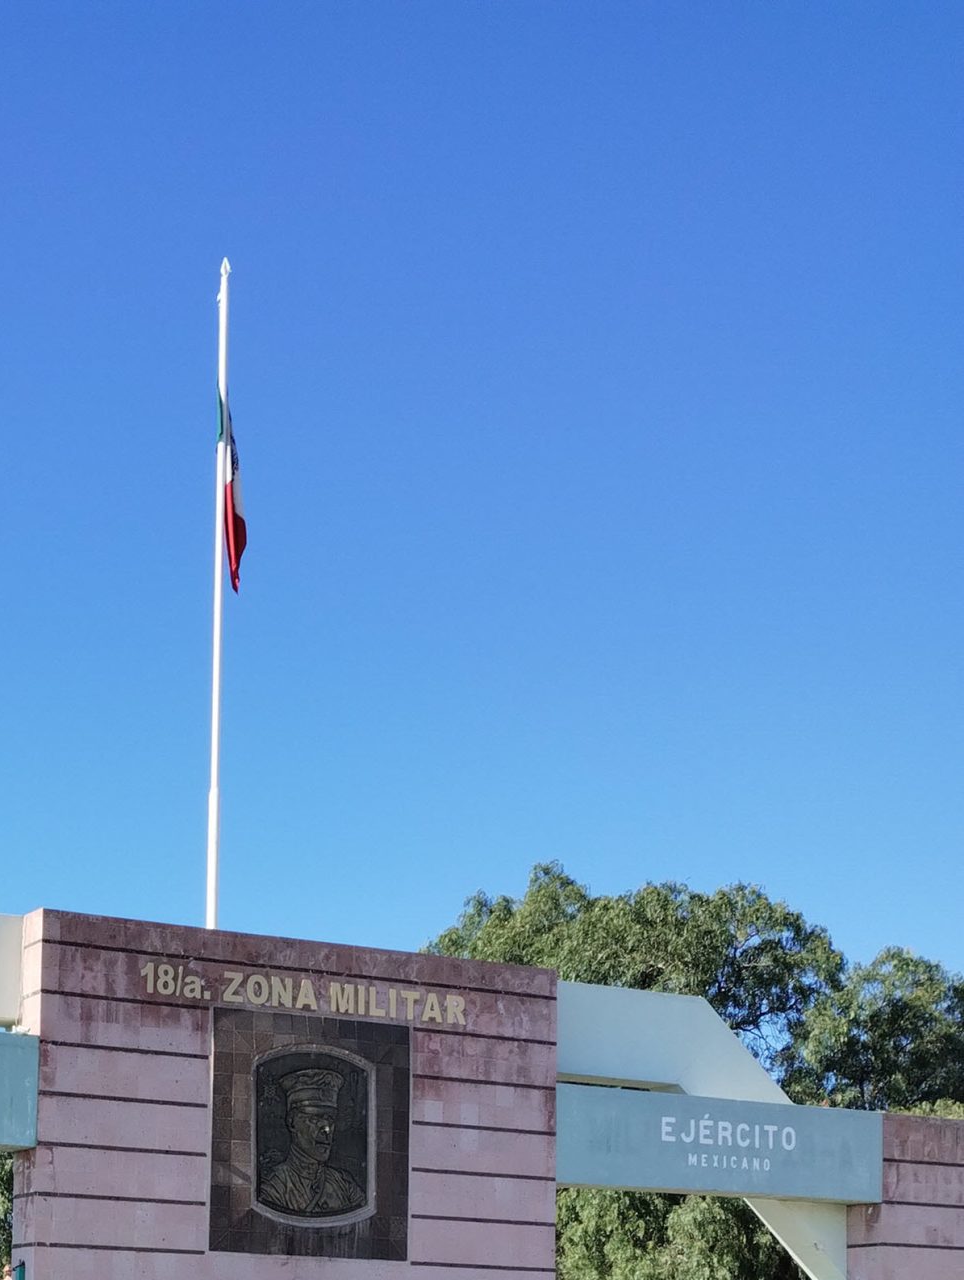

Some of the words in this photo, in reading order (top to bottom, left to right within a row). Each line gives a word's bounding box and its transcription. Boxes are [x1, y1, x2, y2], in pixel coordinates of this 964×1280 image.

[222, 970, 318, 1011] ZONA
[330, 981, 467, 1026] MILITAR
[660, 1113, 797, 1151] EJÉRCITO
[687, 1152, 771, 1172] MEXICANO
